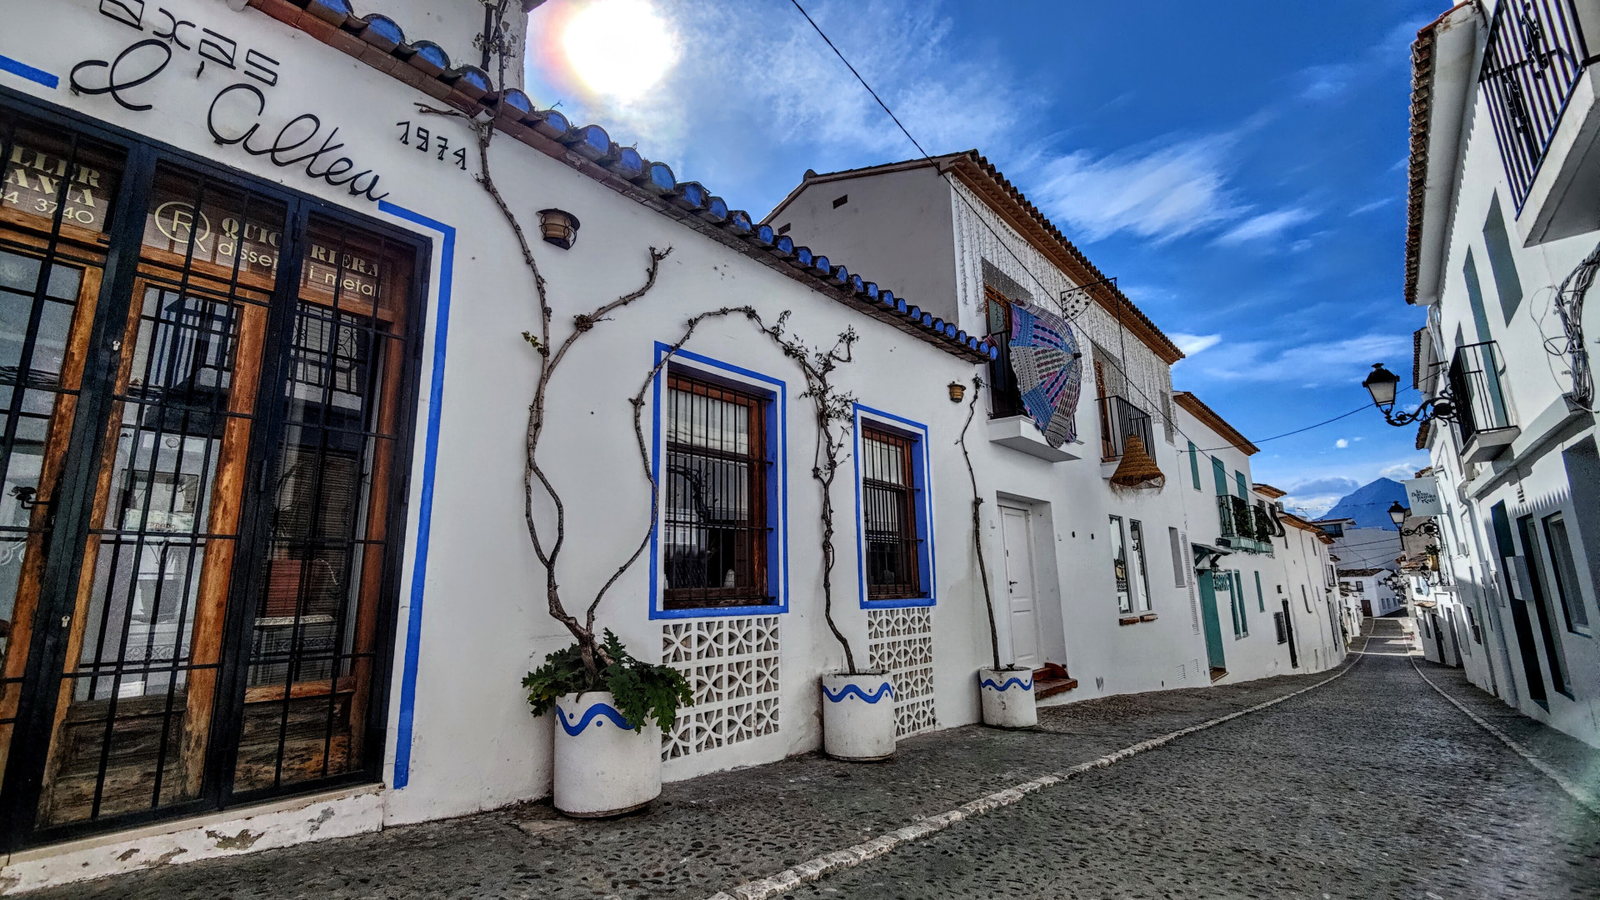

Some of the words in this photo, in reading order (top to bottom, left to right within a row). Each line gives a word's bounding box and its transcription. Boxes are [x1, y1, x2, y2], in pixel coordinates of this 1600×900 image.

[396, 121, 467, 170] 1974
[0, 143, 101, 188] LLER
[34, 198, 95, 224] 3740
[310, 243, 379, 277] RIERA
